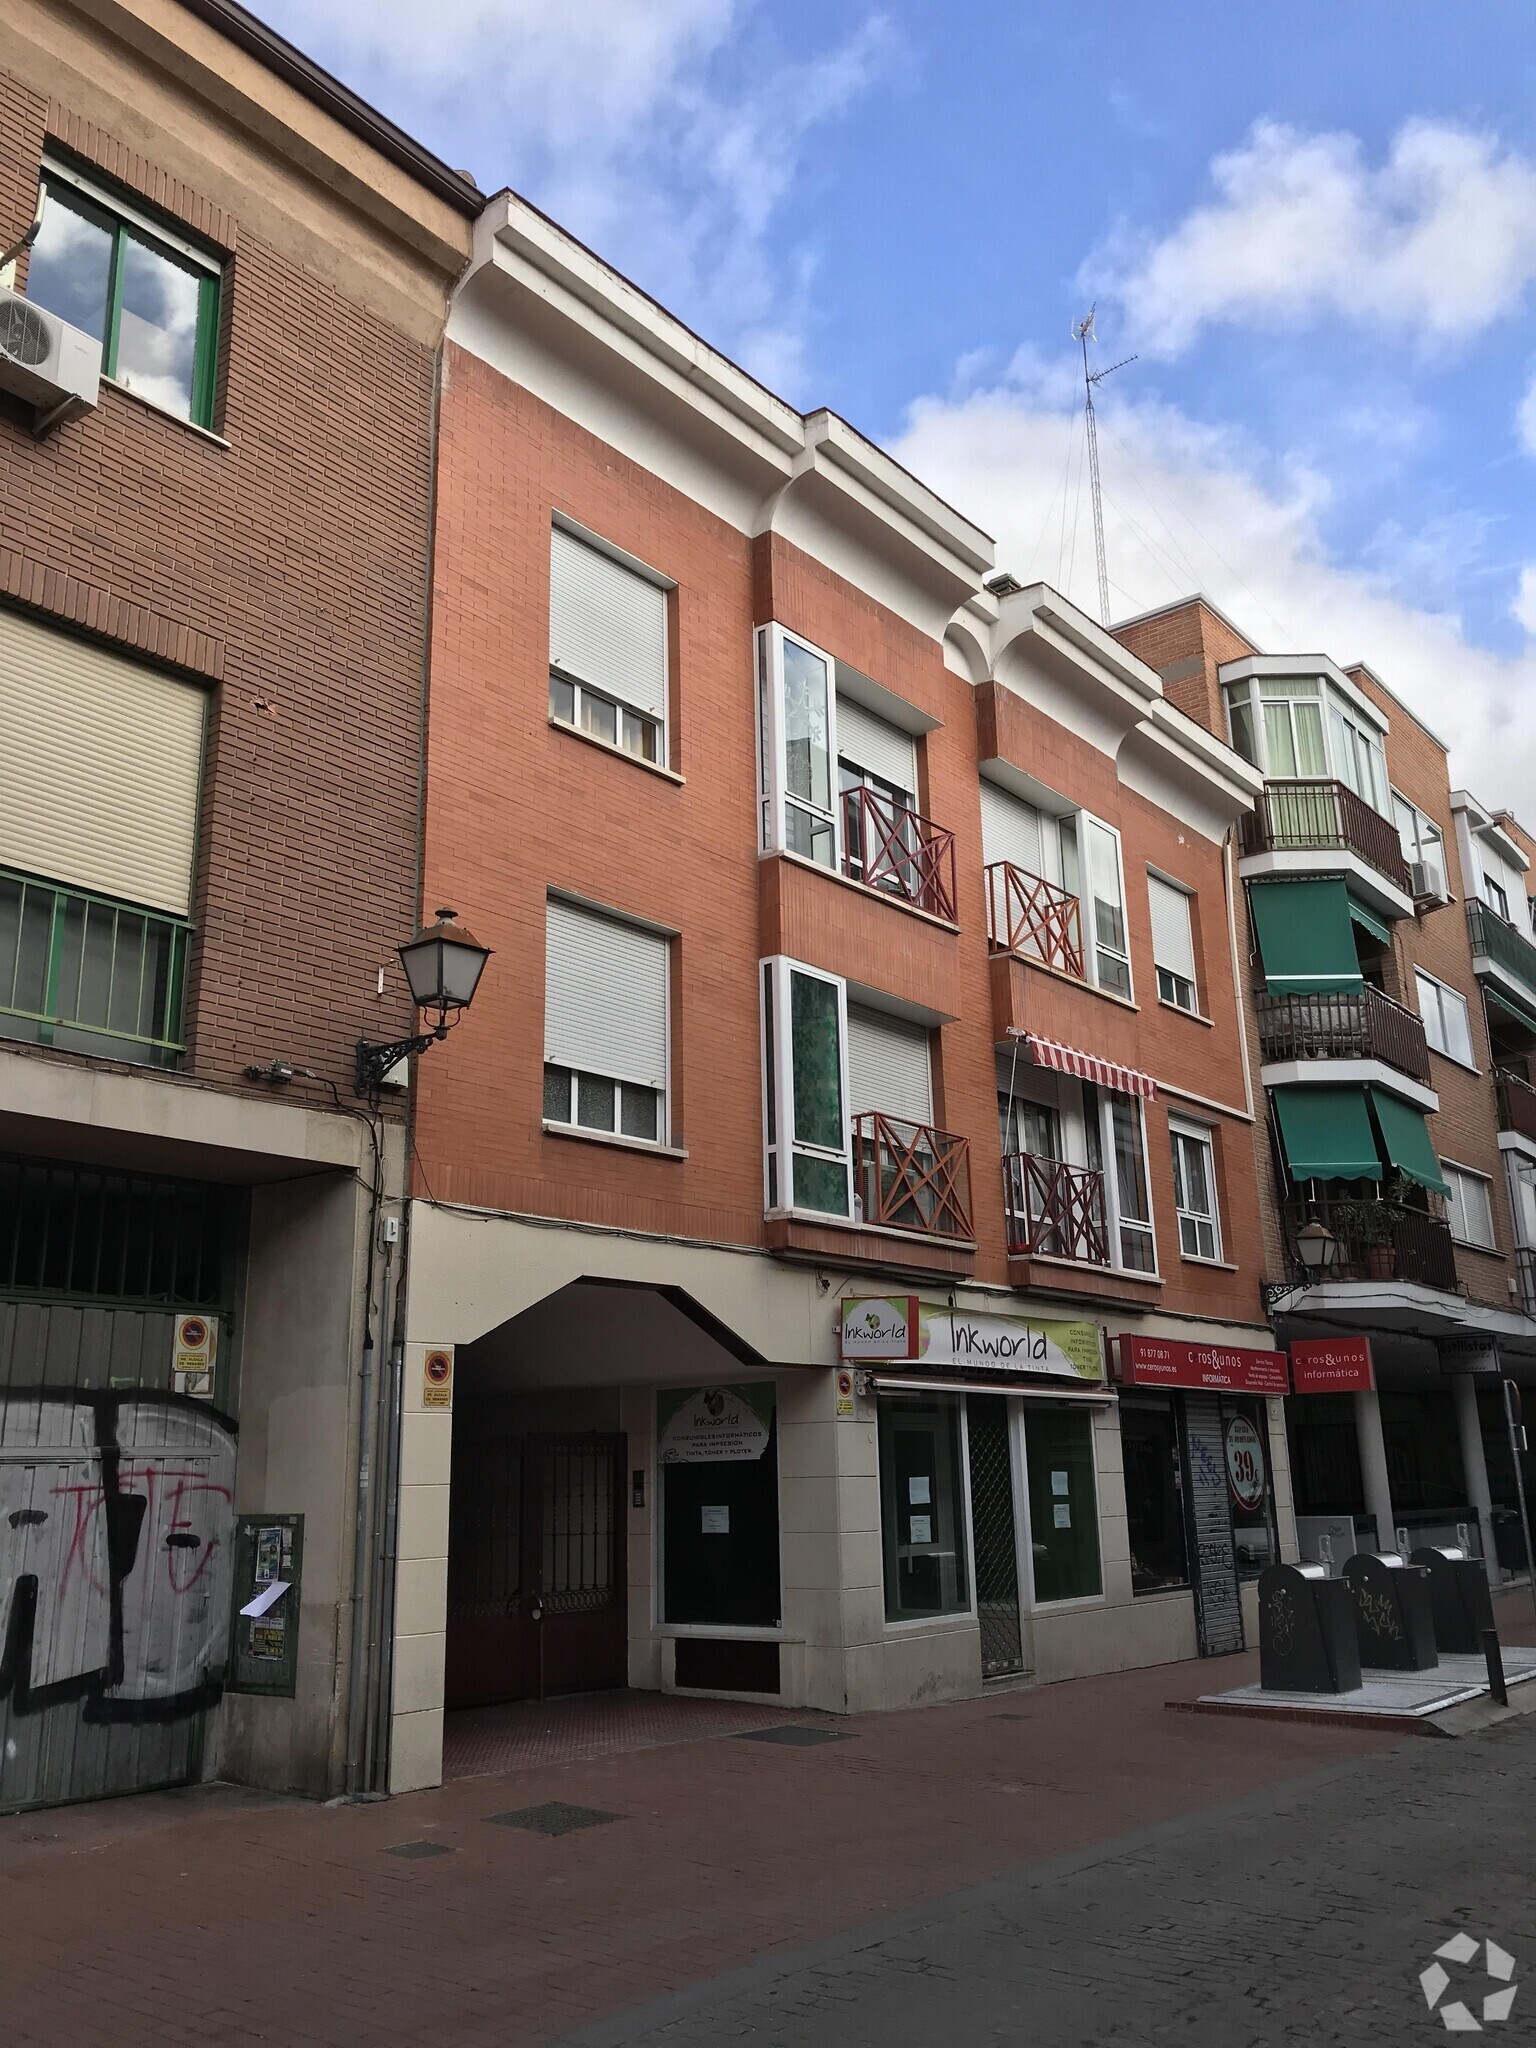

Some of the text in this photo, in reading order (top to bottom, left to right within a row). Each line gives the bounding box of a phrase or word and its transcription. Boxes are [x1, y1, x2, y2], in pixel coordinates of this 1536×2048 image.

[845, 1323, 906, 1340] Inkworld
[950, 1312, 1047, 1360] Inkworld
[1140, 1348, 1146, 1357] 91
[1164, 1351, 1170, 1359] 71
[1188, 1349, 1242, 1370] cros&unos
[966, 1359, 995, 1368] MUNDO
[1202, 1373, 1231, 1384] INFORMÁTICA
[1304, 1369, 1359, 1379] informática
[694, 1413, 739, 1427] Inkworld
